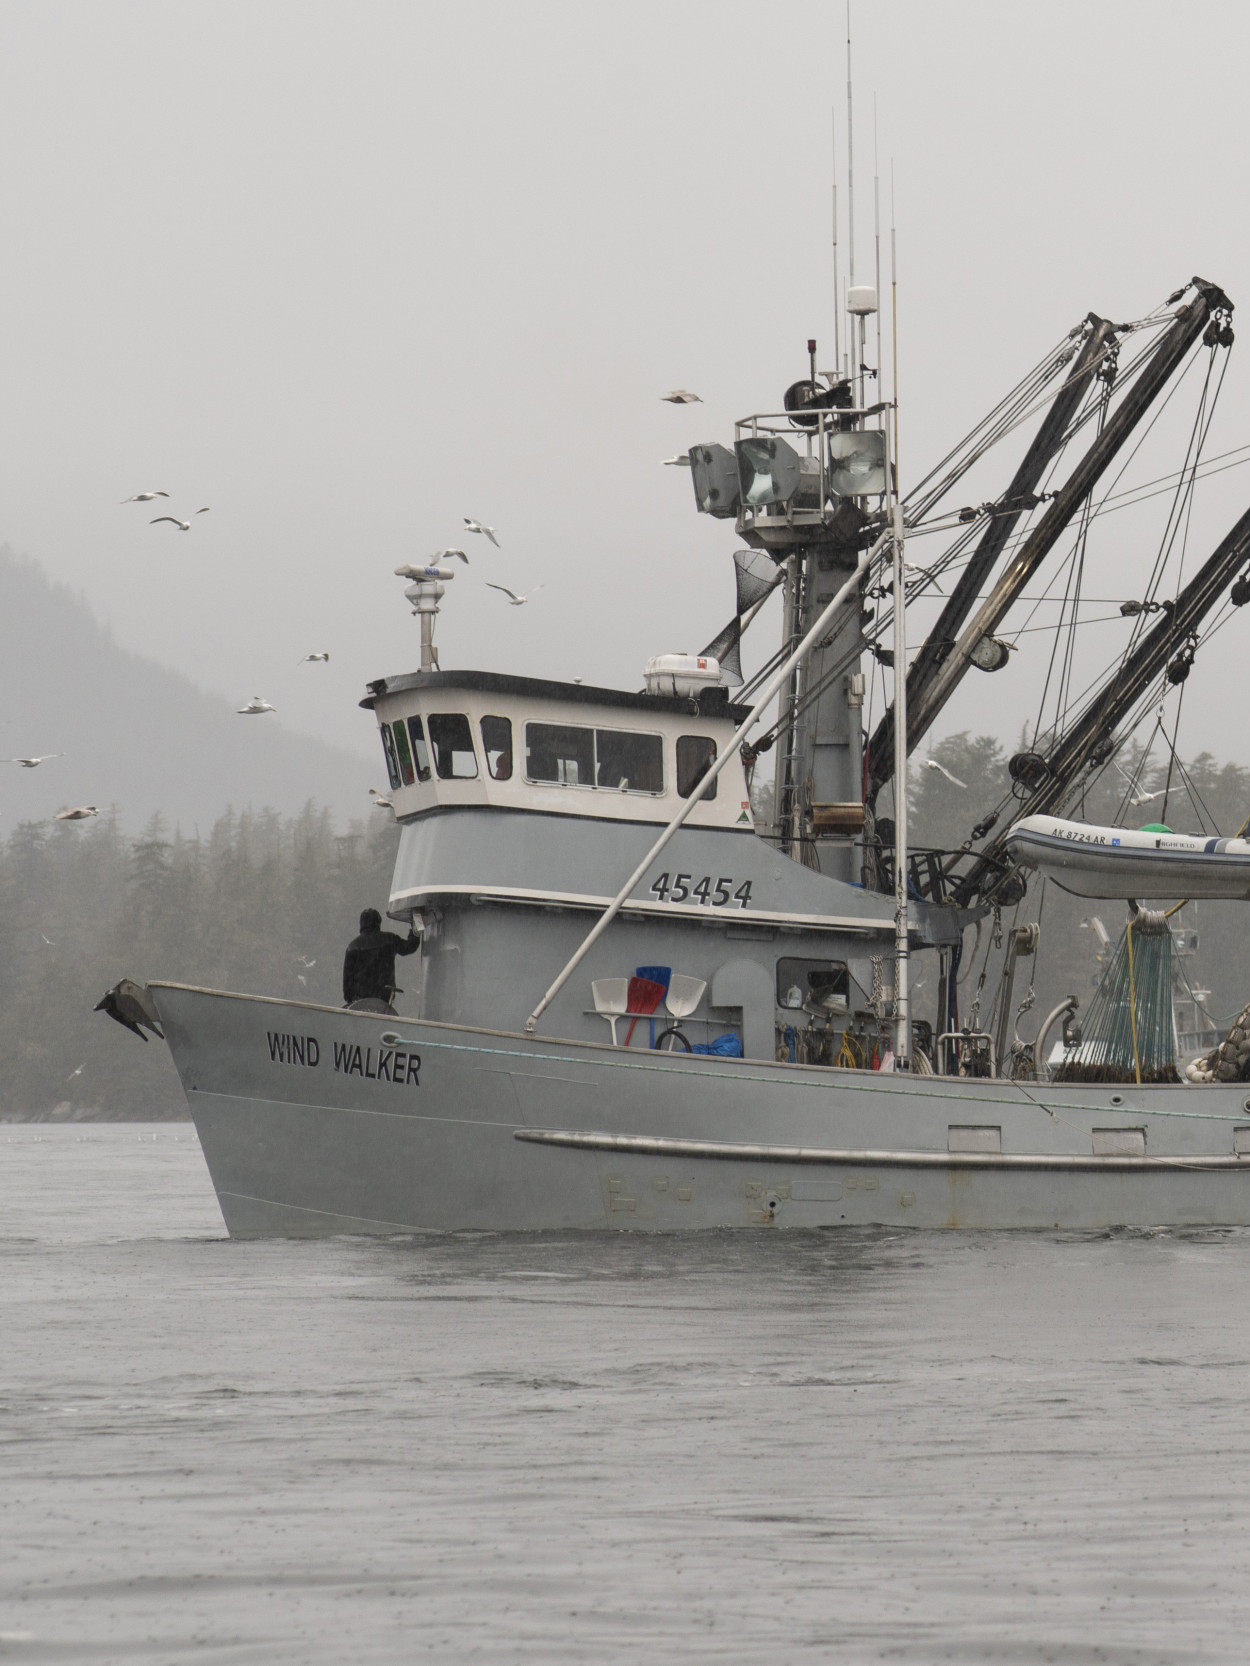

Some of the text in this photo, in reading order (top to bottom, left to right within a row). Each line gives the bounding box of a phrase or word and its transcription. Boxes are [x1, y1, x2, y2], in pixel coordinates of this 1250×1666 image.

[1051, 828, 1106, 845] AK 8724 AR
[649, 872, 753, 910] 45454
[266, 1031, 422, 1087] WIND WALKER
